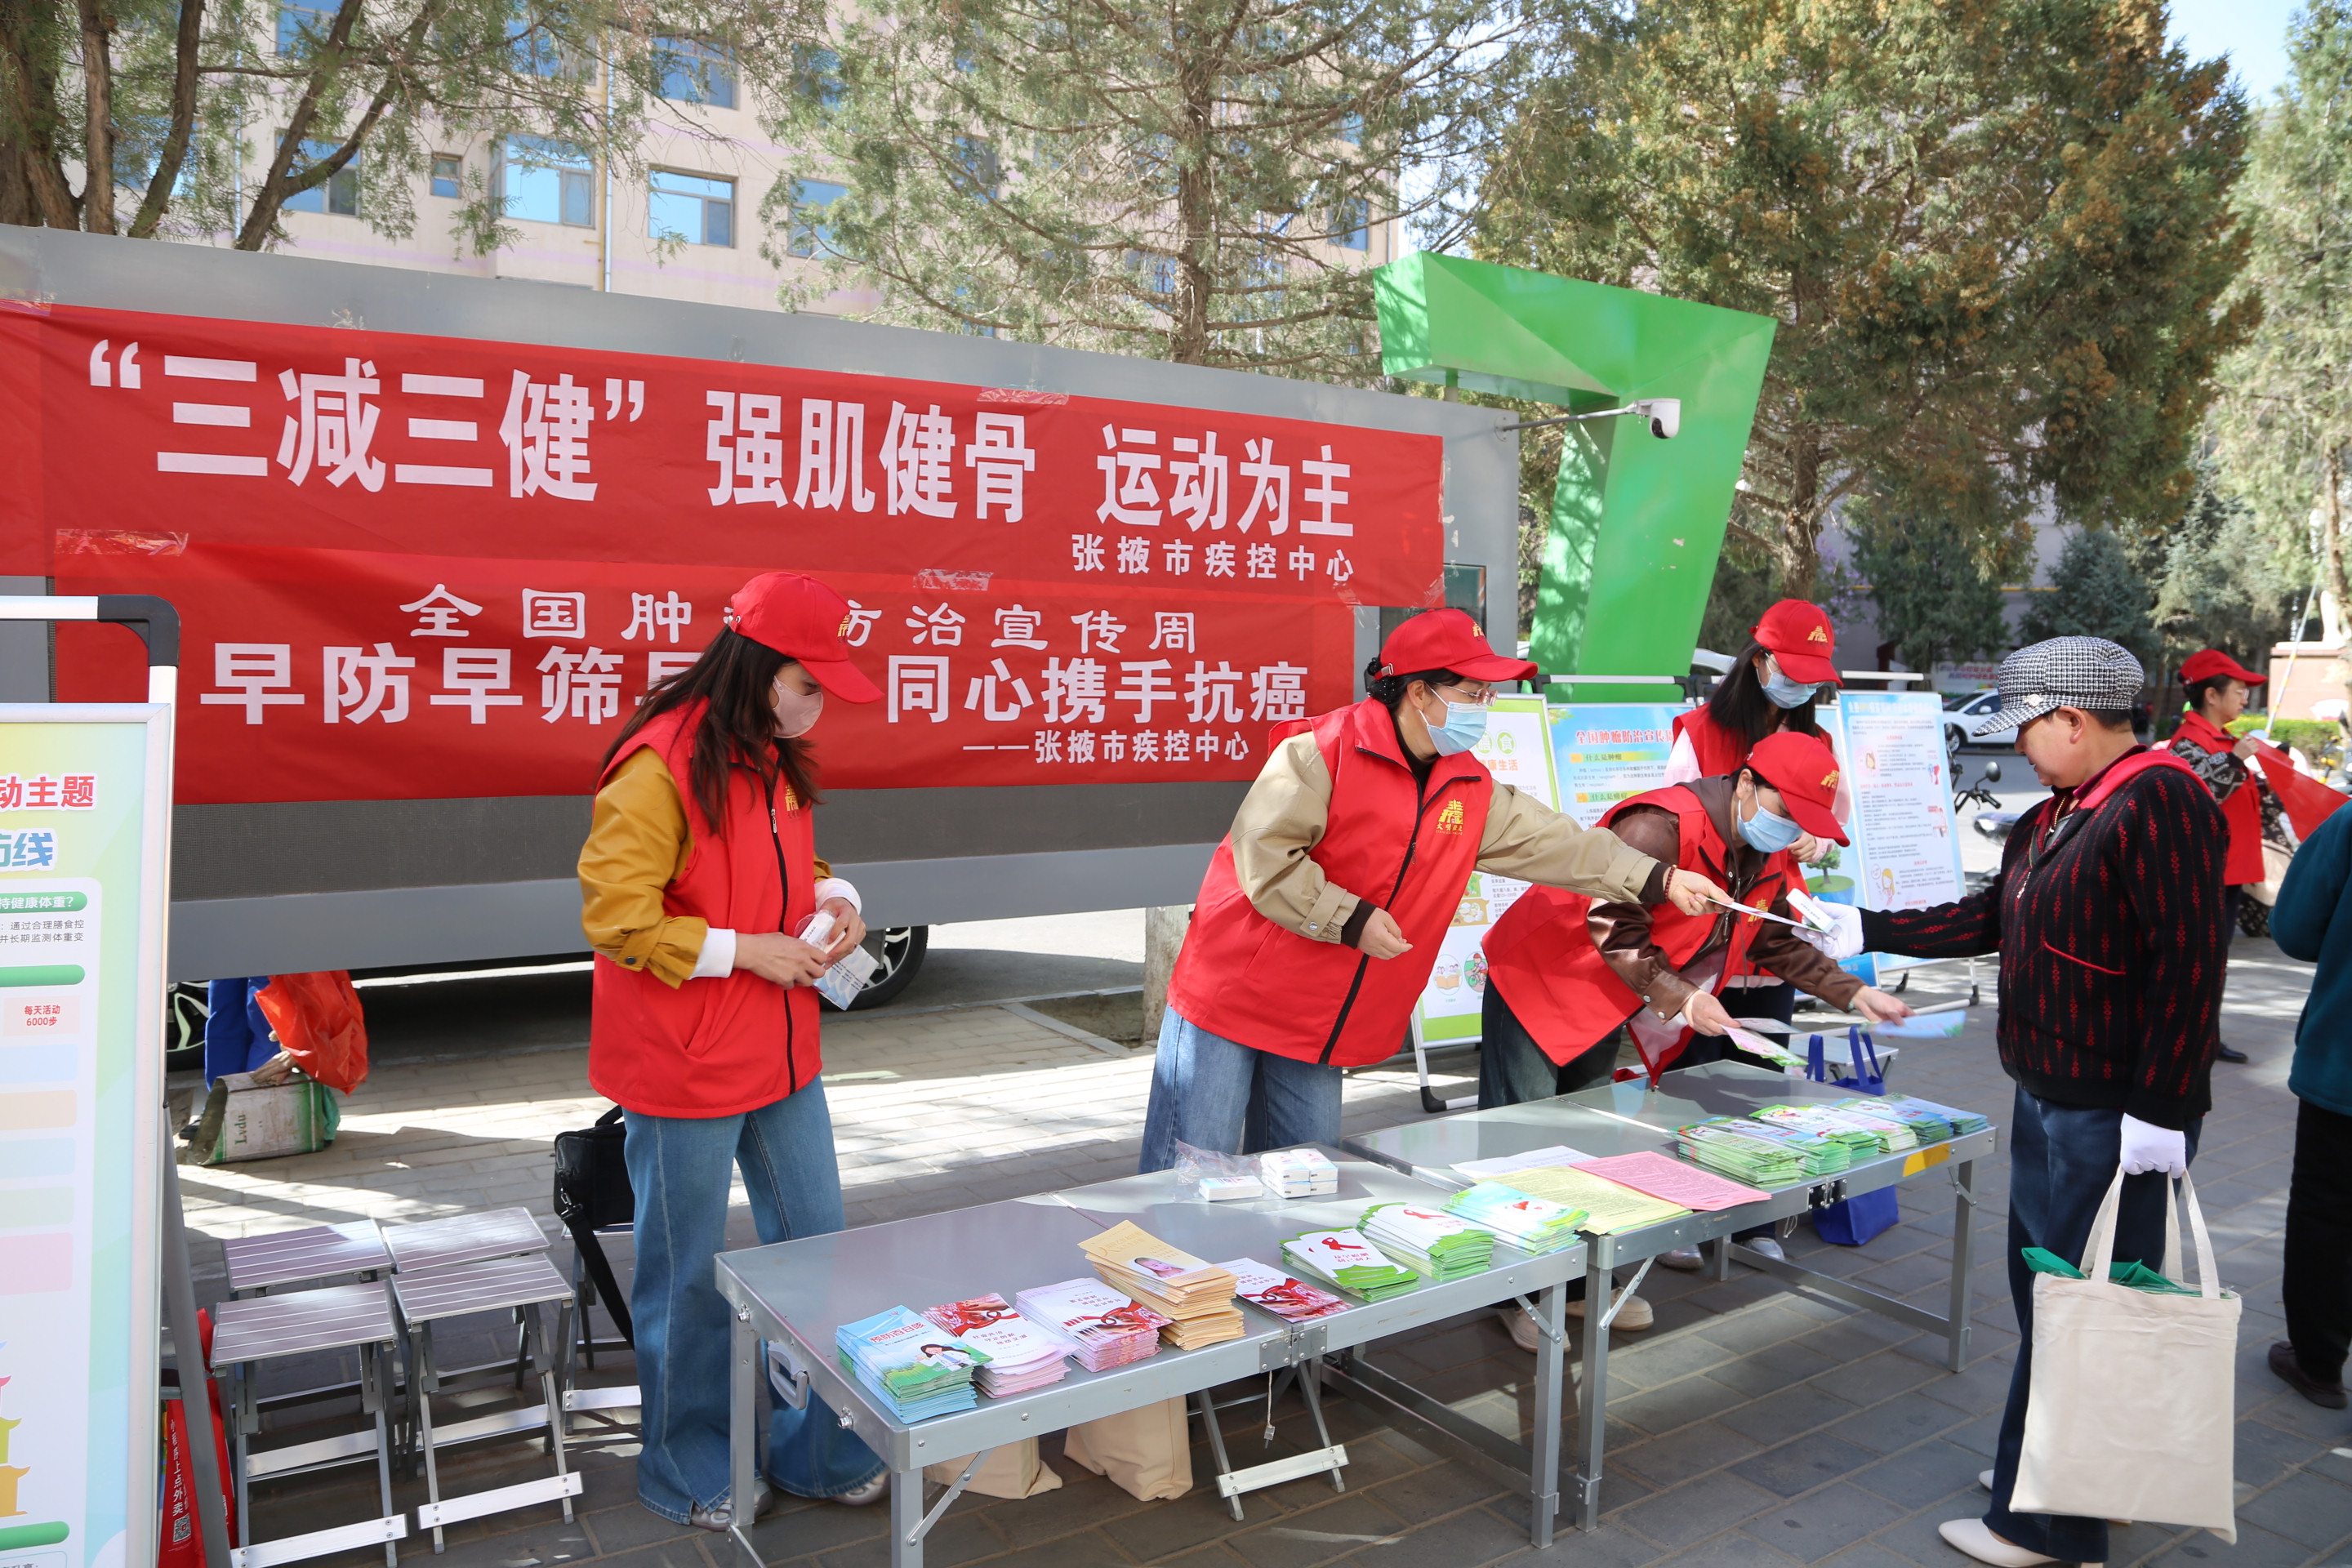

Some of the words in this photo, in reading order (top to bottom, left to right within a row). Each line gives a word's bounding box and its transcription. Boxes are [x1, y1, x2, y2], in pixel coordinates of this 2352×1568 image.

[90, 339, 645, 501] “三减三健”
[706, 390, 1036, 523] 强肌健骨
[1096, 422, 1354, 537] 运动为主
[1072, 533, 1354, 583] 张掖市疾控中心
[888, 655, 1307, 724] 同心携手抗癌
[0, 776, 95, 808] 动主题
[24, 1004, 60, 1015] 每天活动
[26, 1017, 57, 1026] 6000步
[869, 1321, 927, 1343] 预防百日咳
